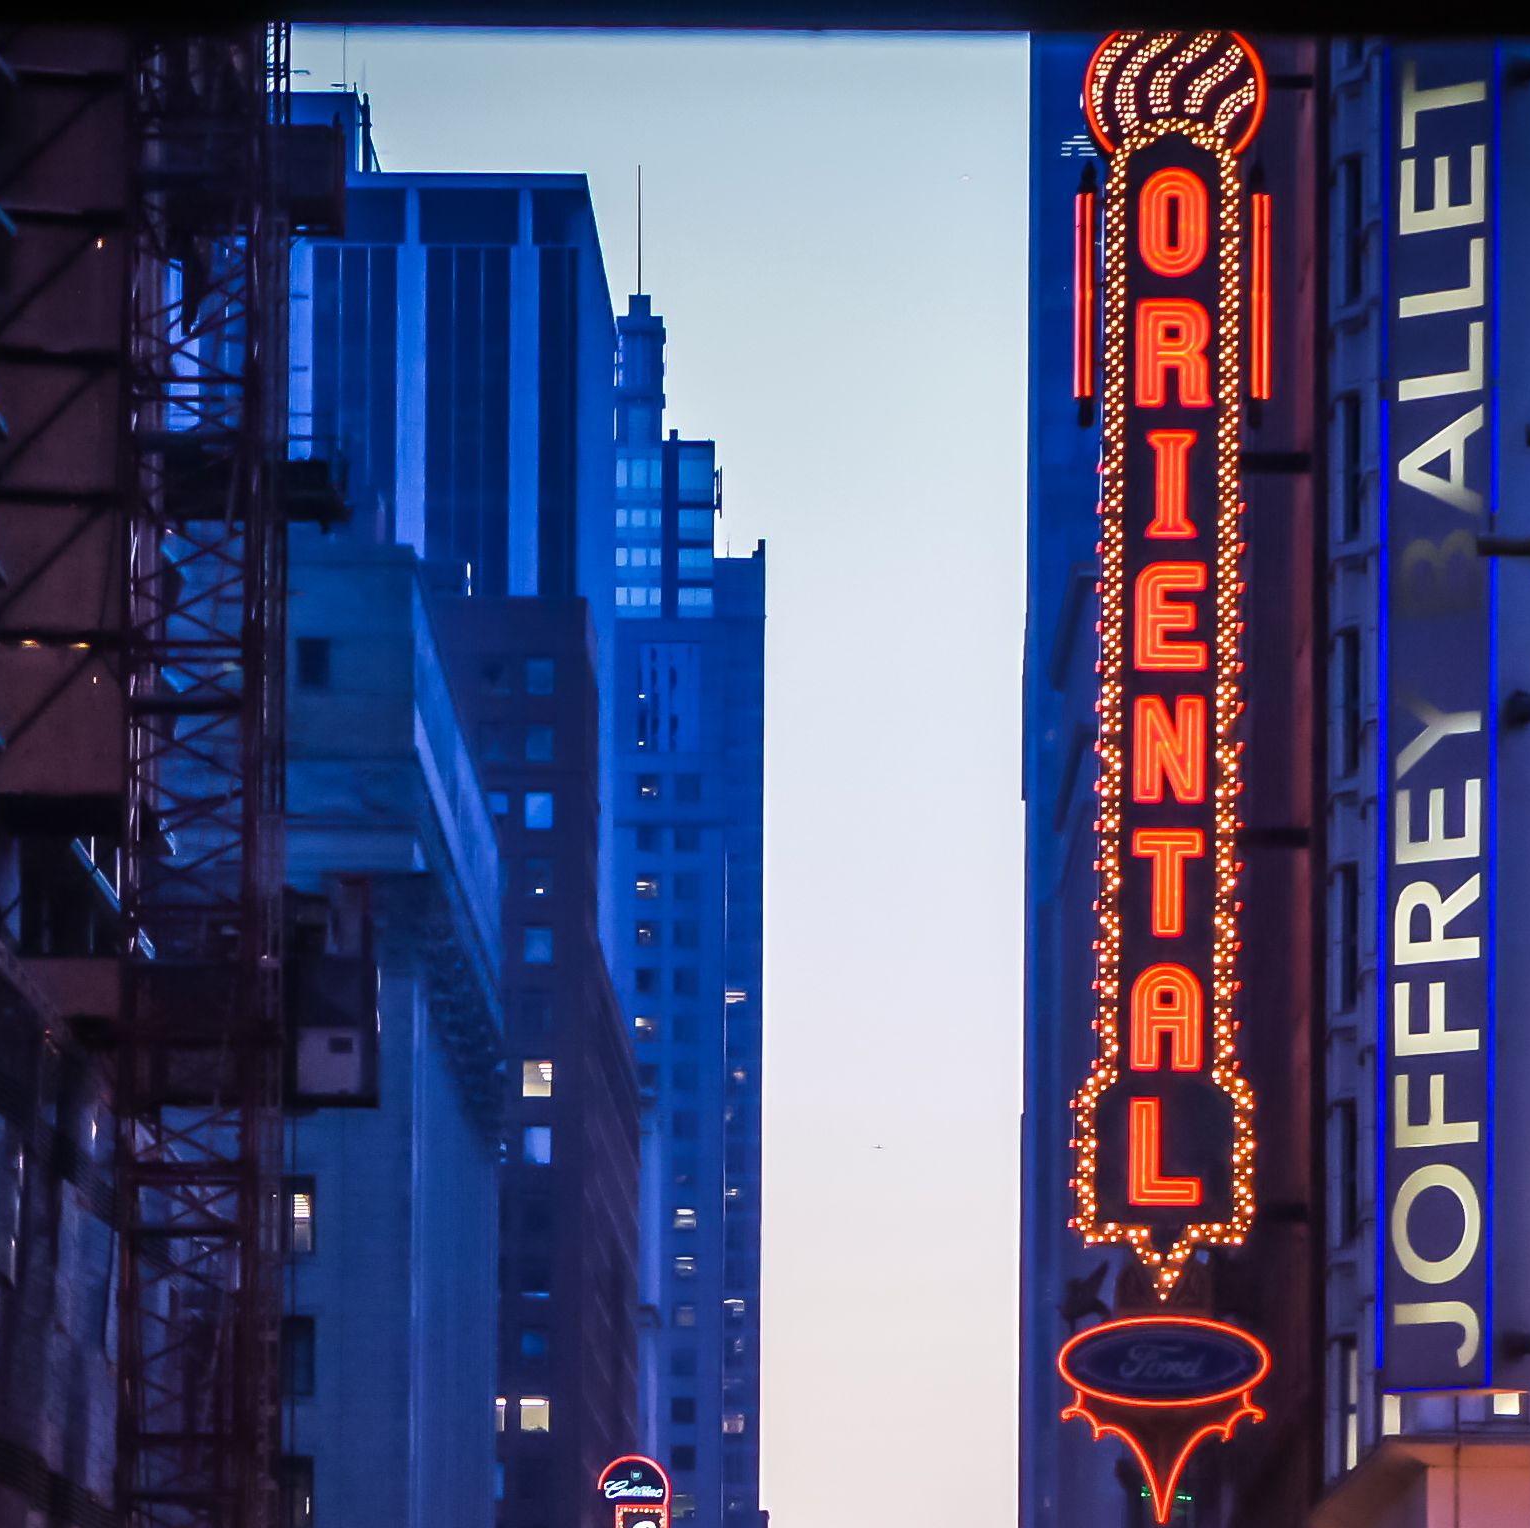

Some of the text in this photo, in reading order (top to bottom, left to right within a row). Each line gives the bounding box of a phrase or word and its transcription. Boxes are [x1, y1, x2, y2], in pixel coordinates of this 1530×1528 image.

[1127, 166, 1214, 1207] ORIENTAL
[1390, 58, 1486, 1369] JOFFREY BALLET
[603, 1480, 664, 1499] Cadillac
[1119, 1343, 1204, 1381] Ford
